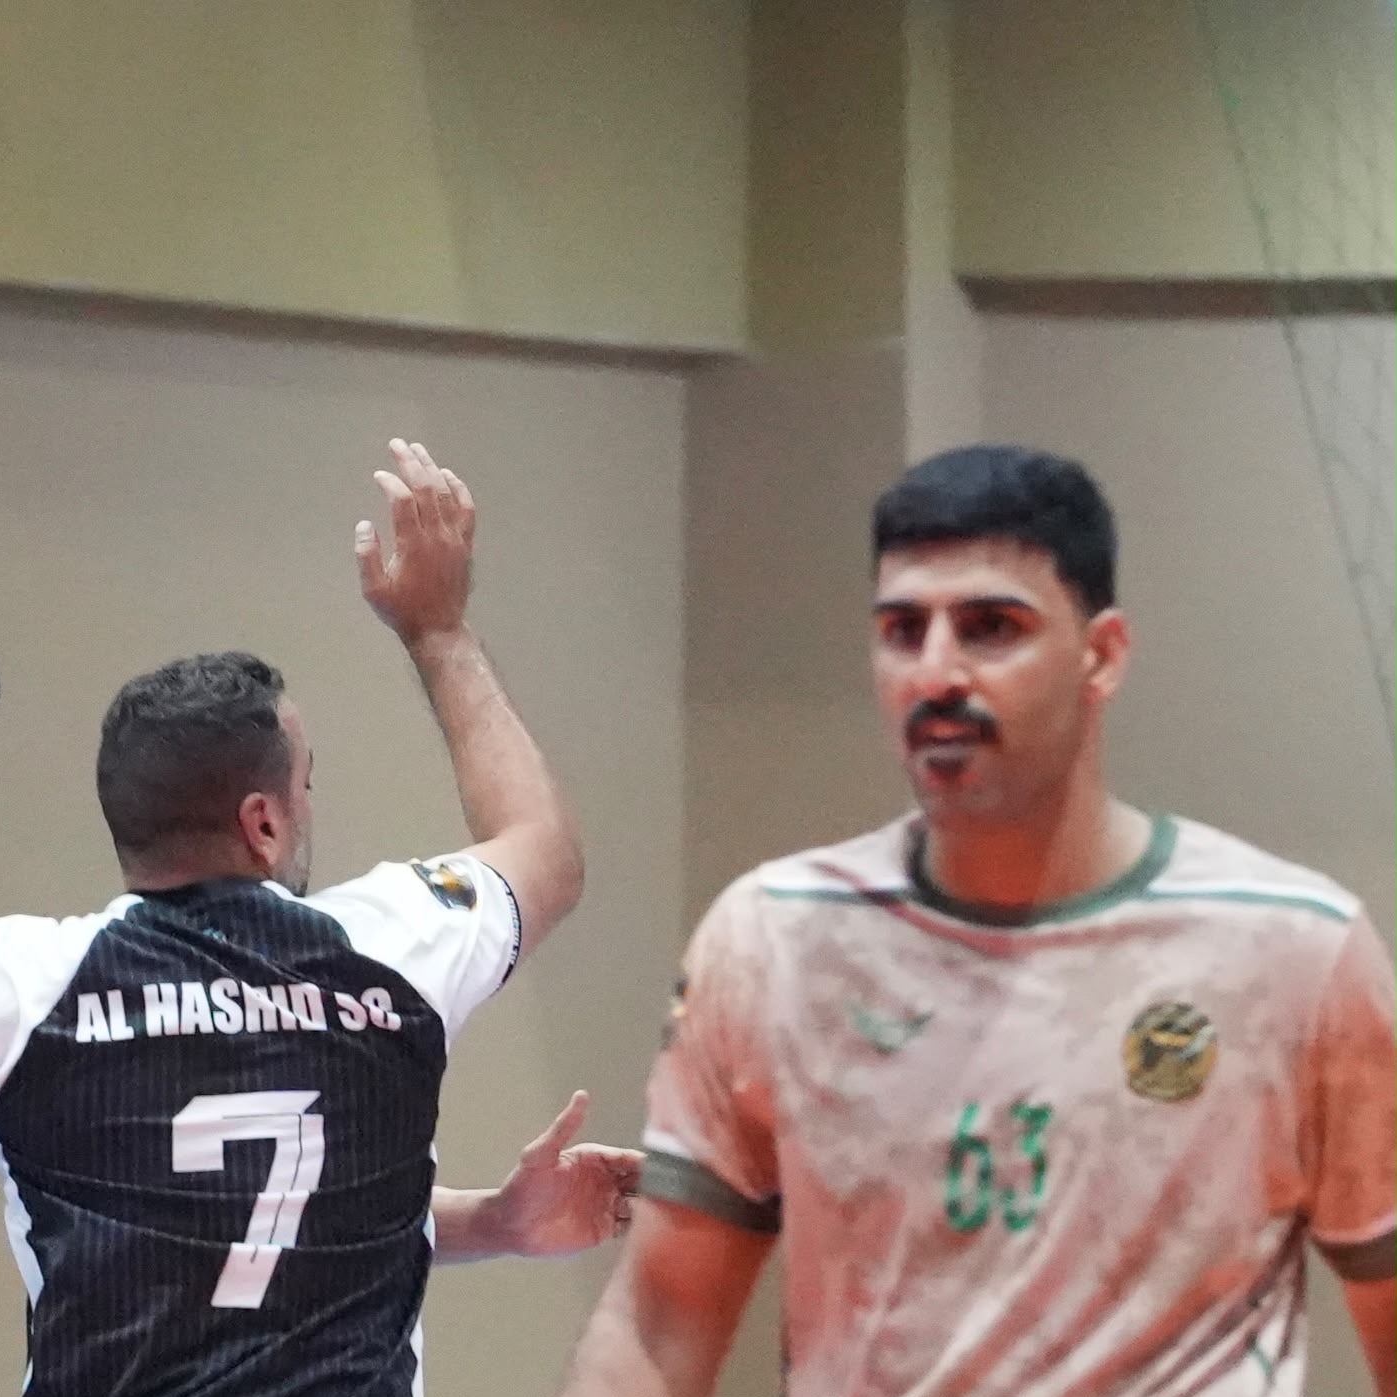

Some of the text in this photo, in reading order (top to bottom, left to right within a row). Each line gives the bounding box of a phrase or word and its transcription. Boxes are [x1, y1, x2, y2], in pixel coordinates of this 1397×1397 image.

[76, 989, 134, 1043] AL
[172, 1090, 325, 1309] 7
[945, 1103, 1052, 1232] 63
